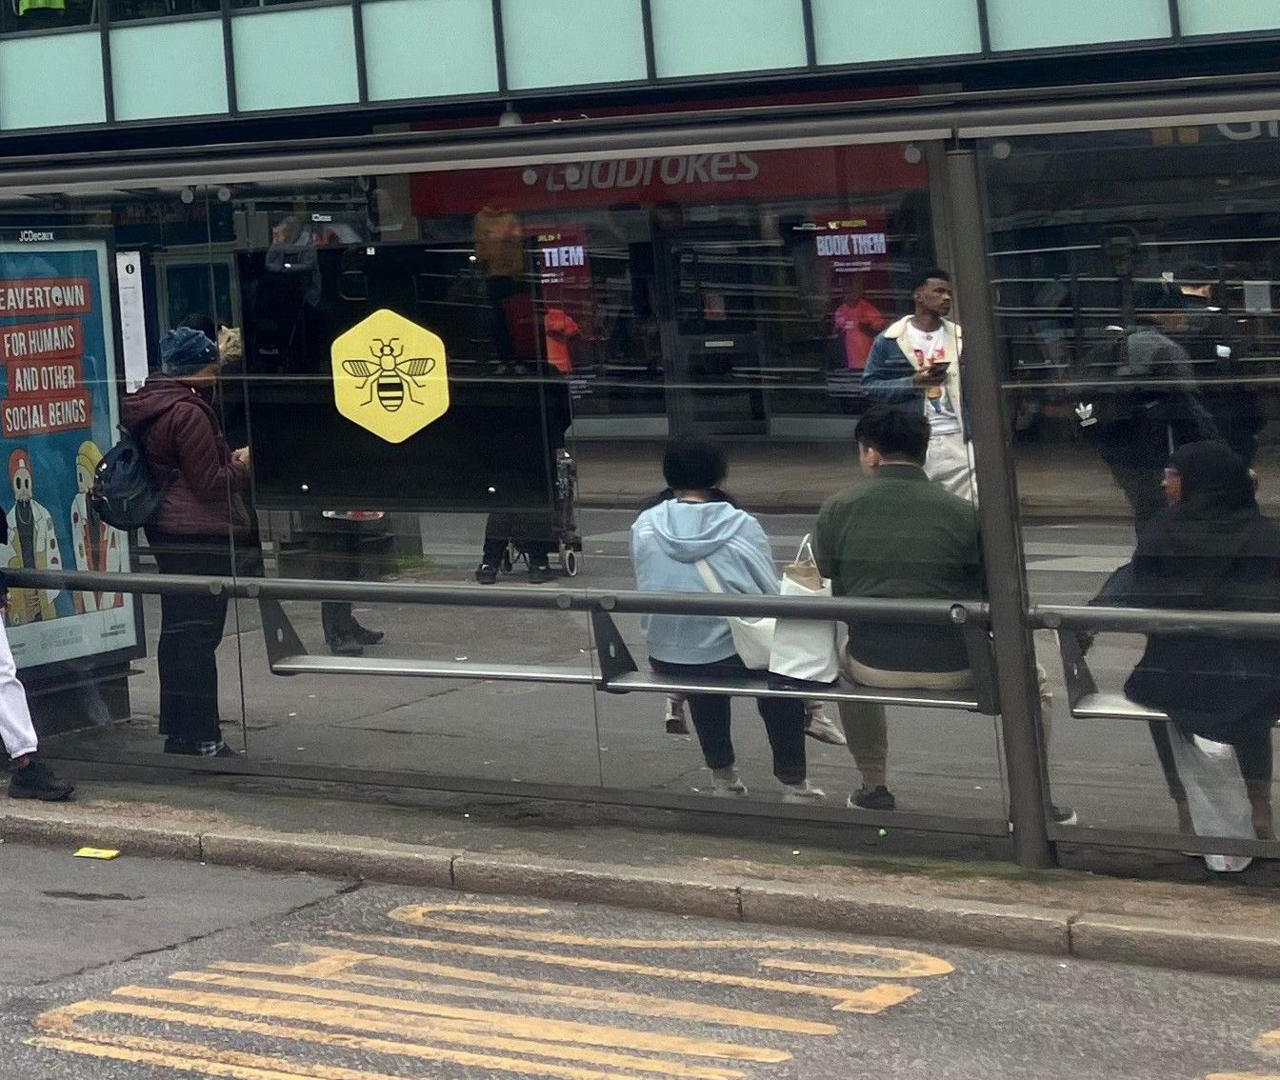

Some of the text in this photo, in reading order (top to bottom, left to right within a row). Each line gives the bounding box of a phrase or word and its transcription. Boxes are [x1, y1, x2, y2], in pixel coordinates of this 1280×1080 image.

[18, 230, 54, 242] JCDecaux
[816, 233, 886, 256] BOOK THEM
[3, 325, 75, 358] FOR HUMANS
[15, 365, 76, 393] AND OTHER
[5, 399, 86, 432] SOCIAL BEINGS
